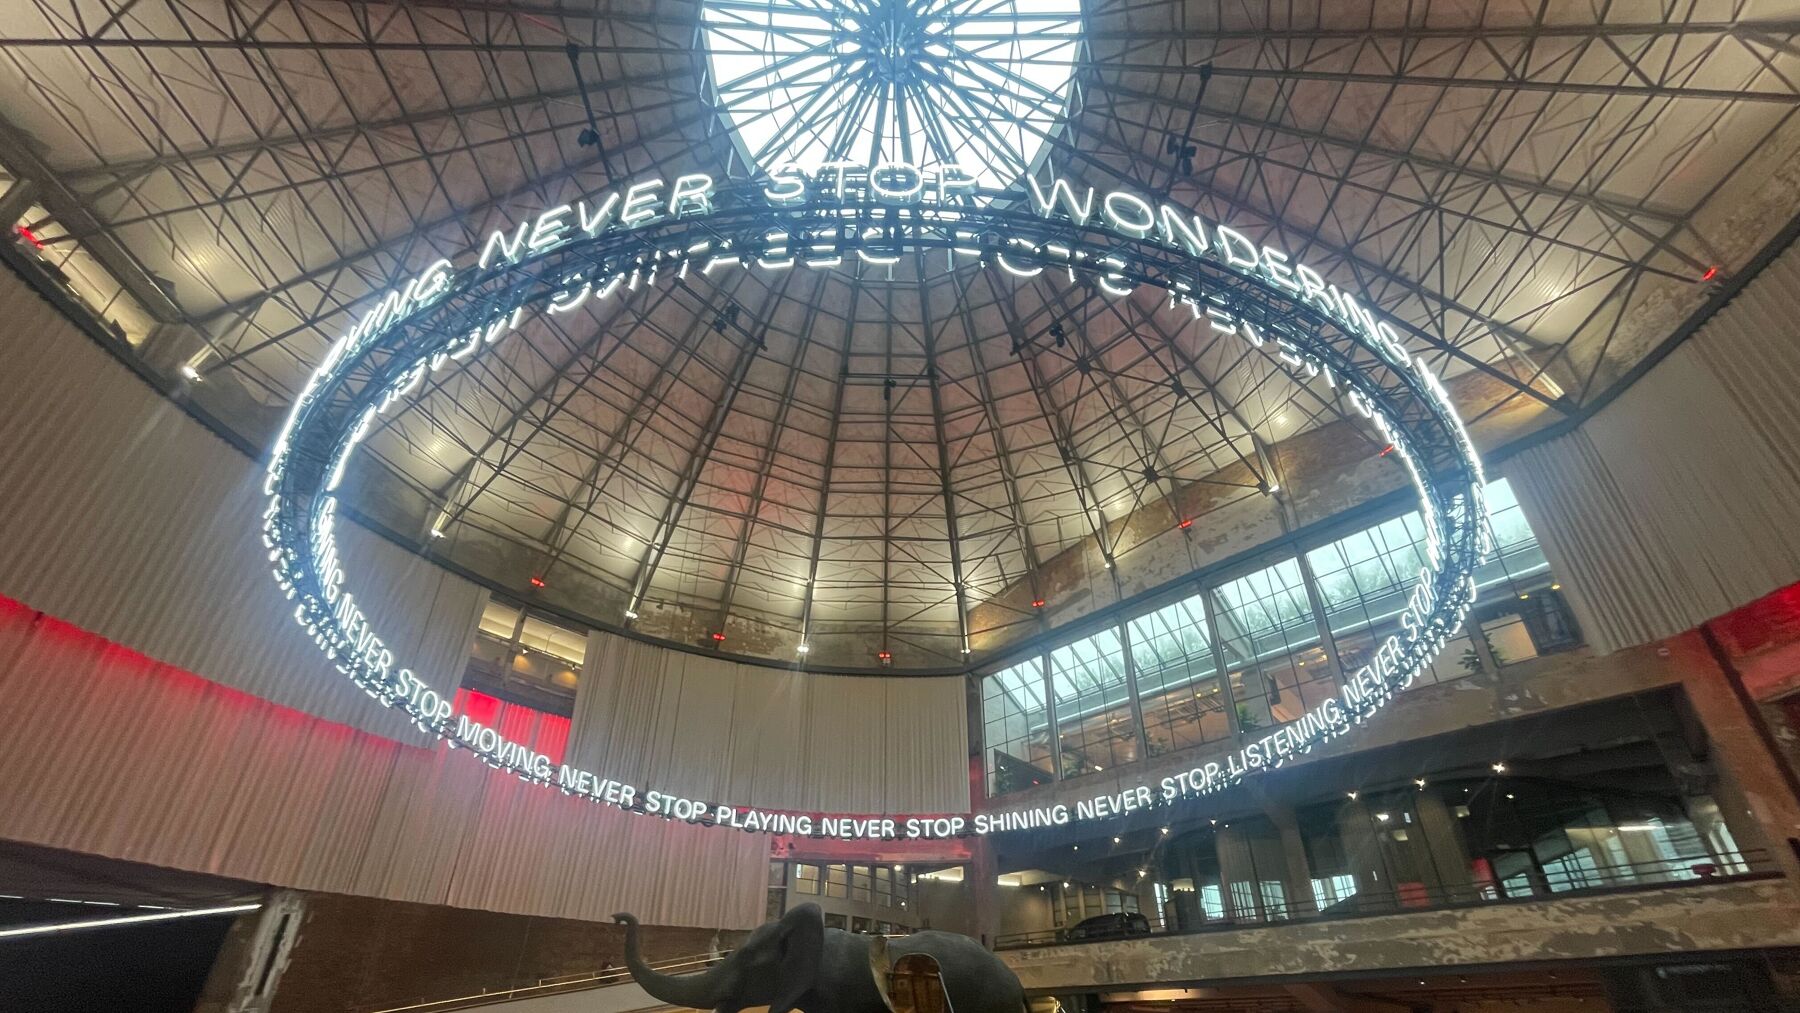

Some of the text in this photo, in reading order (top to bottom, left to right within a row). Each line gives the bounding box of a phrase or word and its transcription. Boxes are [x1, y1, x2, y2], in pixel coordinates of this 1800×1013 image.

[479, 173, 714, 268] NEVER
[764, 160, 979, 202] STOP
[1026, 172, 1412, 368] WONDERING
[336, 592, 394, 680] NEVER
[395, 668, 452, 723] STOP
[456, 715, 552, 777] MOVING
[557, 764, 636, 808] NEVER
[645, 790, 707, 820] STOP
[715, 806, 812, 836] PLAYING
[821, 816, 896, 839] NEVER
[906, 816, 965, 838] STOP
[974, 804, 1070, 835] SHINING
[1077, 786, 1152, 822] NEVER
[1160, 762, 1220, 798] STOP
[1226, 698, 1343, 778] LISTENING
[1342, 634, 1404, 710] NEVER
[1402, 566, 1438, 644] STOP
